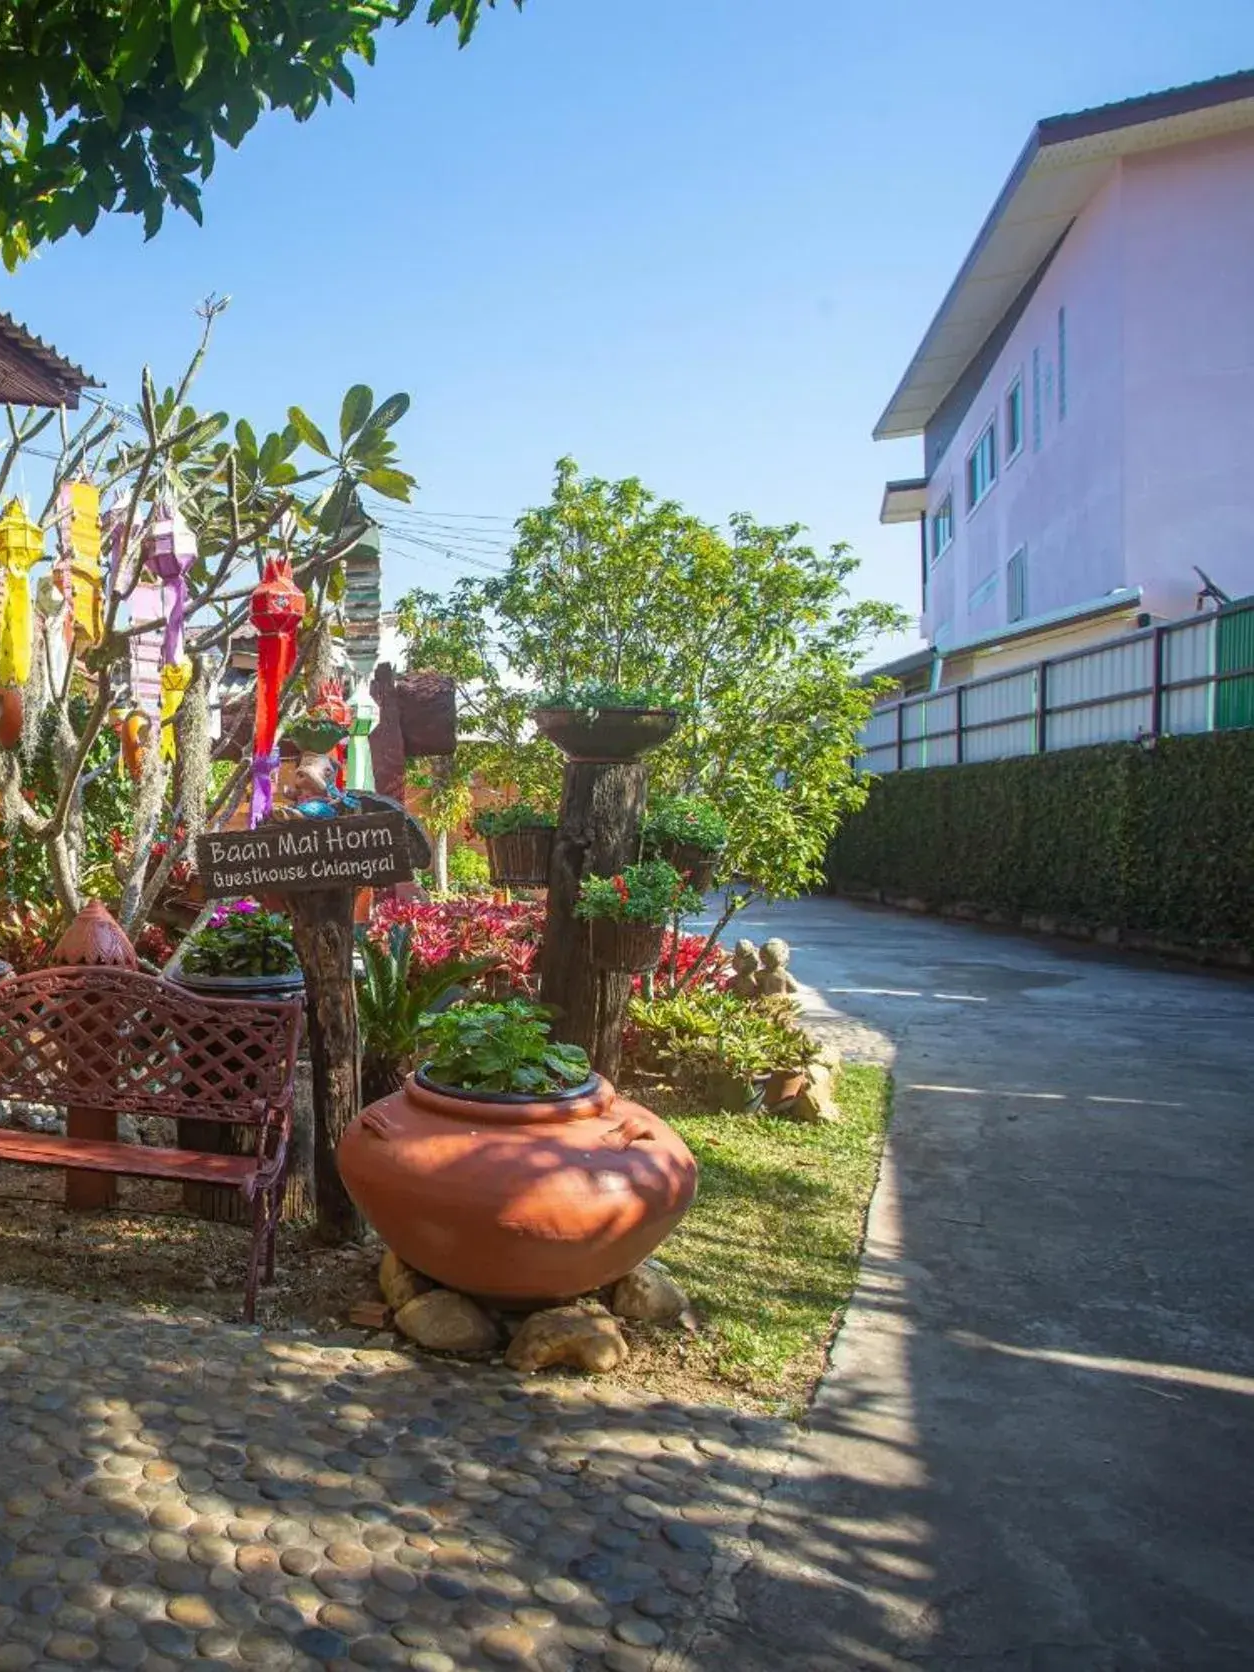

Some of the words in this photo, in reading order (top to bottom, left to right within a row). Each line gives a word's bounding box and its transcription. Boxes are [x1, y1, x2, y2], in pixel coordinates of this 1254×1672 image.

[210, 840, 271, 864] Baan
[278, 830, 319, 857] Mai
[326, 826, 393, 852] Horm
[213, 864, 306, 888] Guesthouse
[311, 853, 395, 879] Chiangrai
